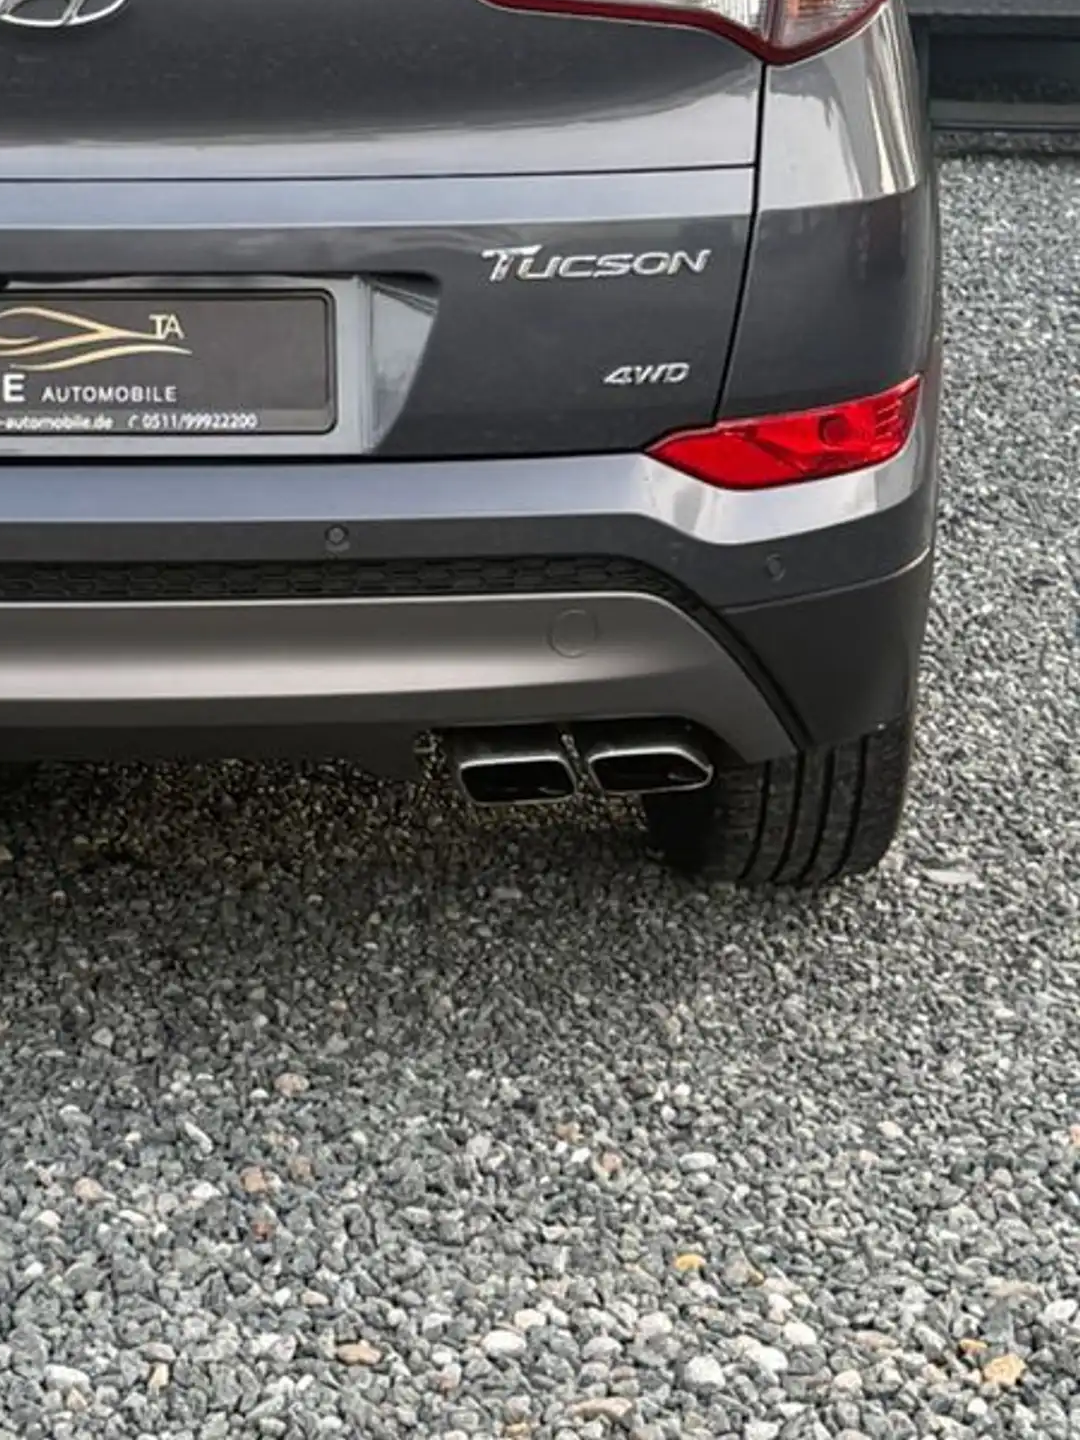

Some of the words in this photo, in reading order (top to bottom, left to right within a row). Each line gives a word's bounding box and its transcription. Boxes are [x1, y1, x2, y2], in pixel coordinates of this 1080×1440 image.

[481, 243, 713, 283] TUCSON
[602, 362, 691, 385] 4WD
[41, 385, 178, 403] AUTOMOBILE
